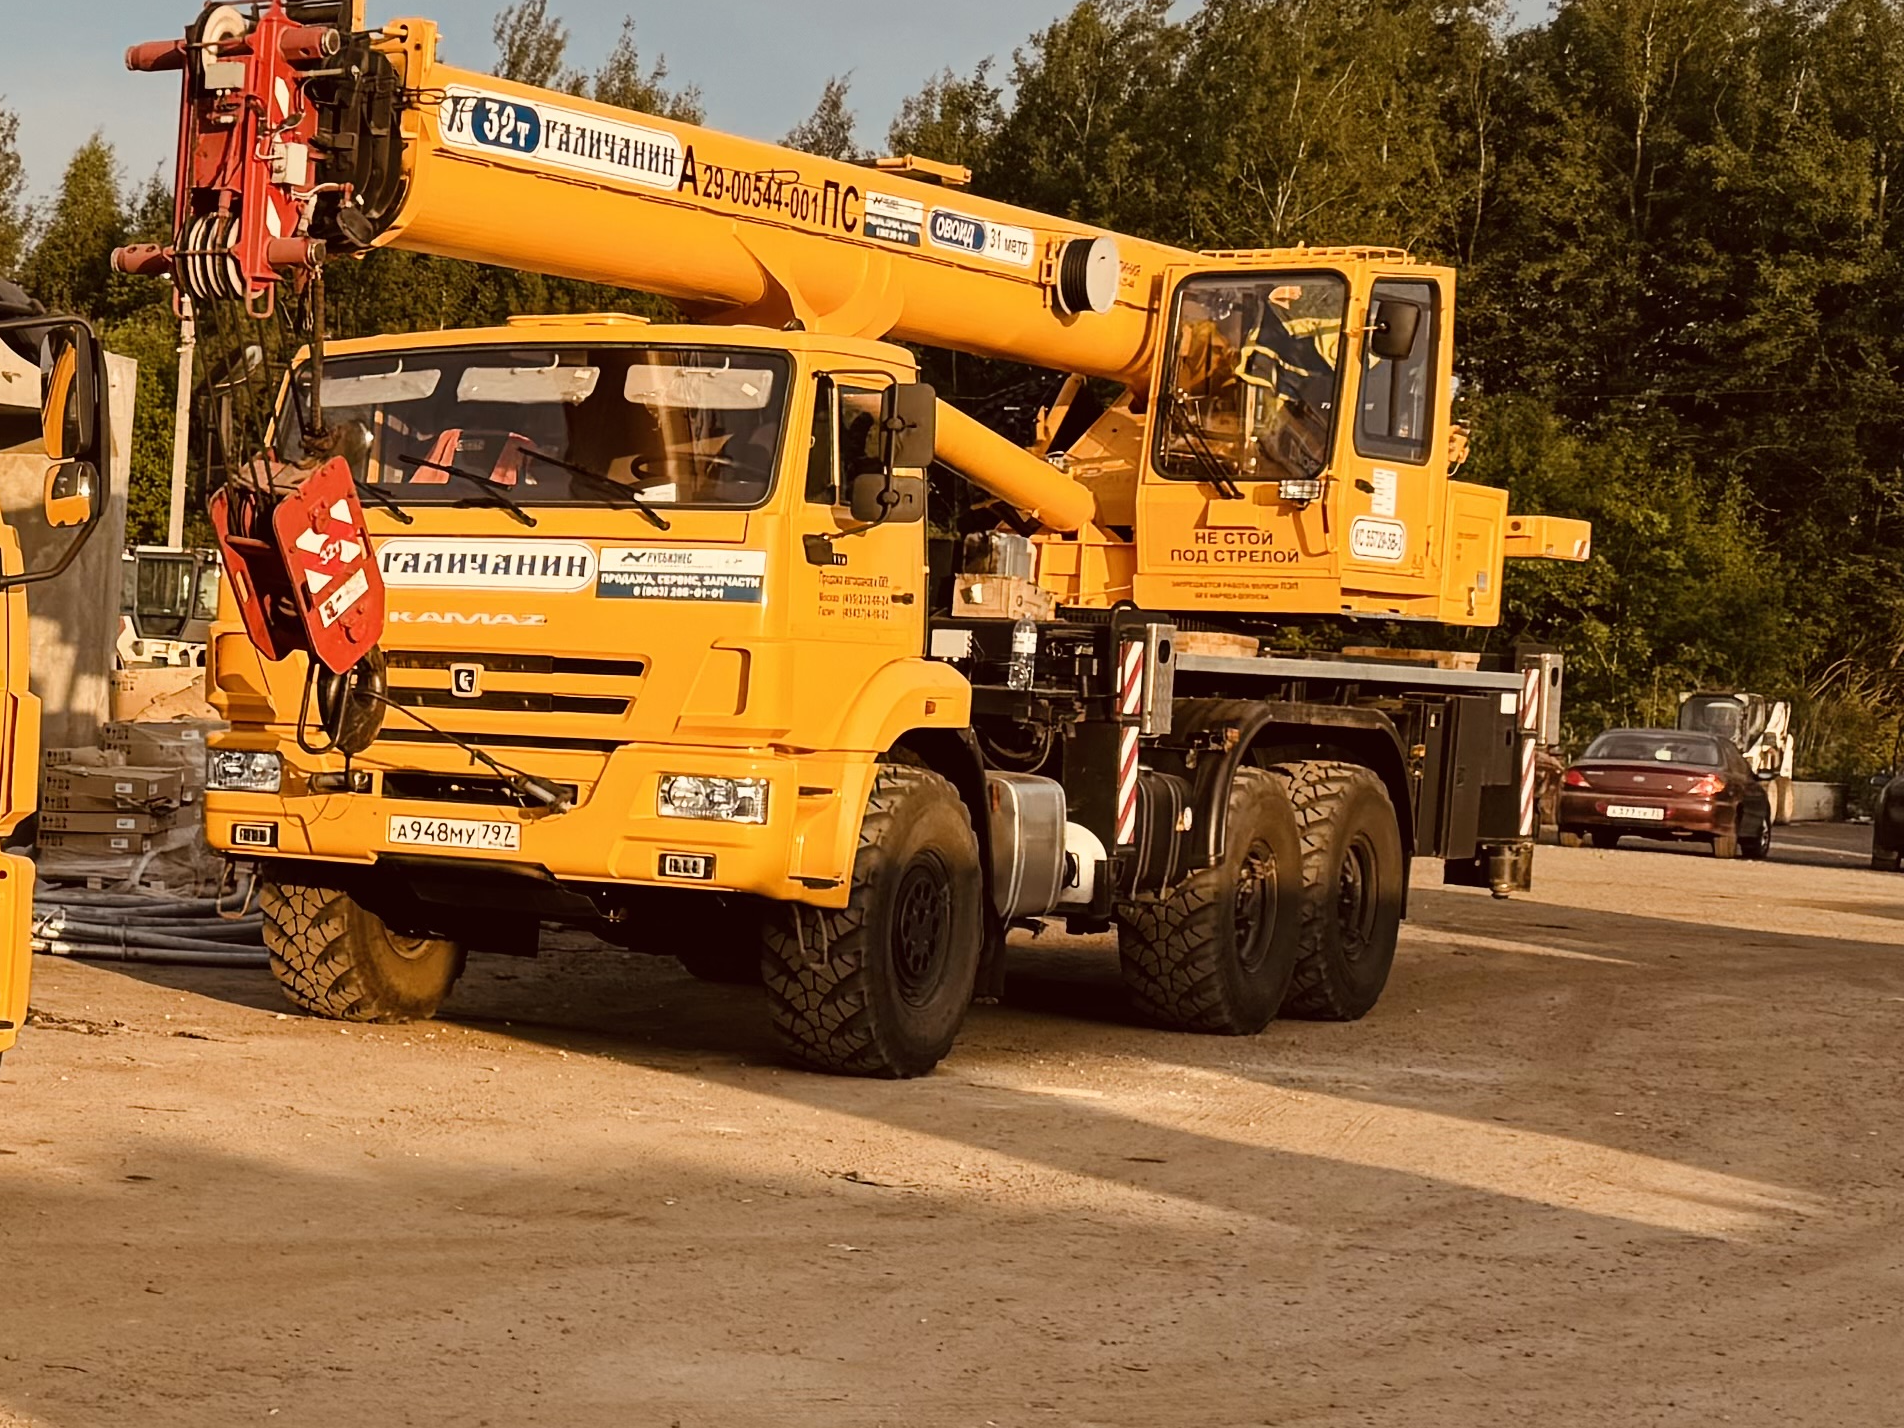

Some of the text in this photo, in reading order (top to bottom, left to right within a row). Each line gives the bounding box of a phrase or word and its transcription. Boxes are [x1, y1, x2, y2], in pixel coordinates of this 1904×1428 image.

[544, 119, 676, 177] ГАЛИЧАНИН
[935, 216, 976, 249] ОВОИД
[990, 228, 1001, 249] 31
[1195, 529, 1274, 546] НЕ СТОЙ
[382, 552, 588, 578] ГАЛИЧАНИН
[1170, 547, 1300, 564] ПОД СТРЕЛОЙ
[388, 611, 548, 627] KAMAZ
[396, 820, 476, 845] А948МУ
